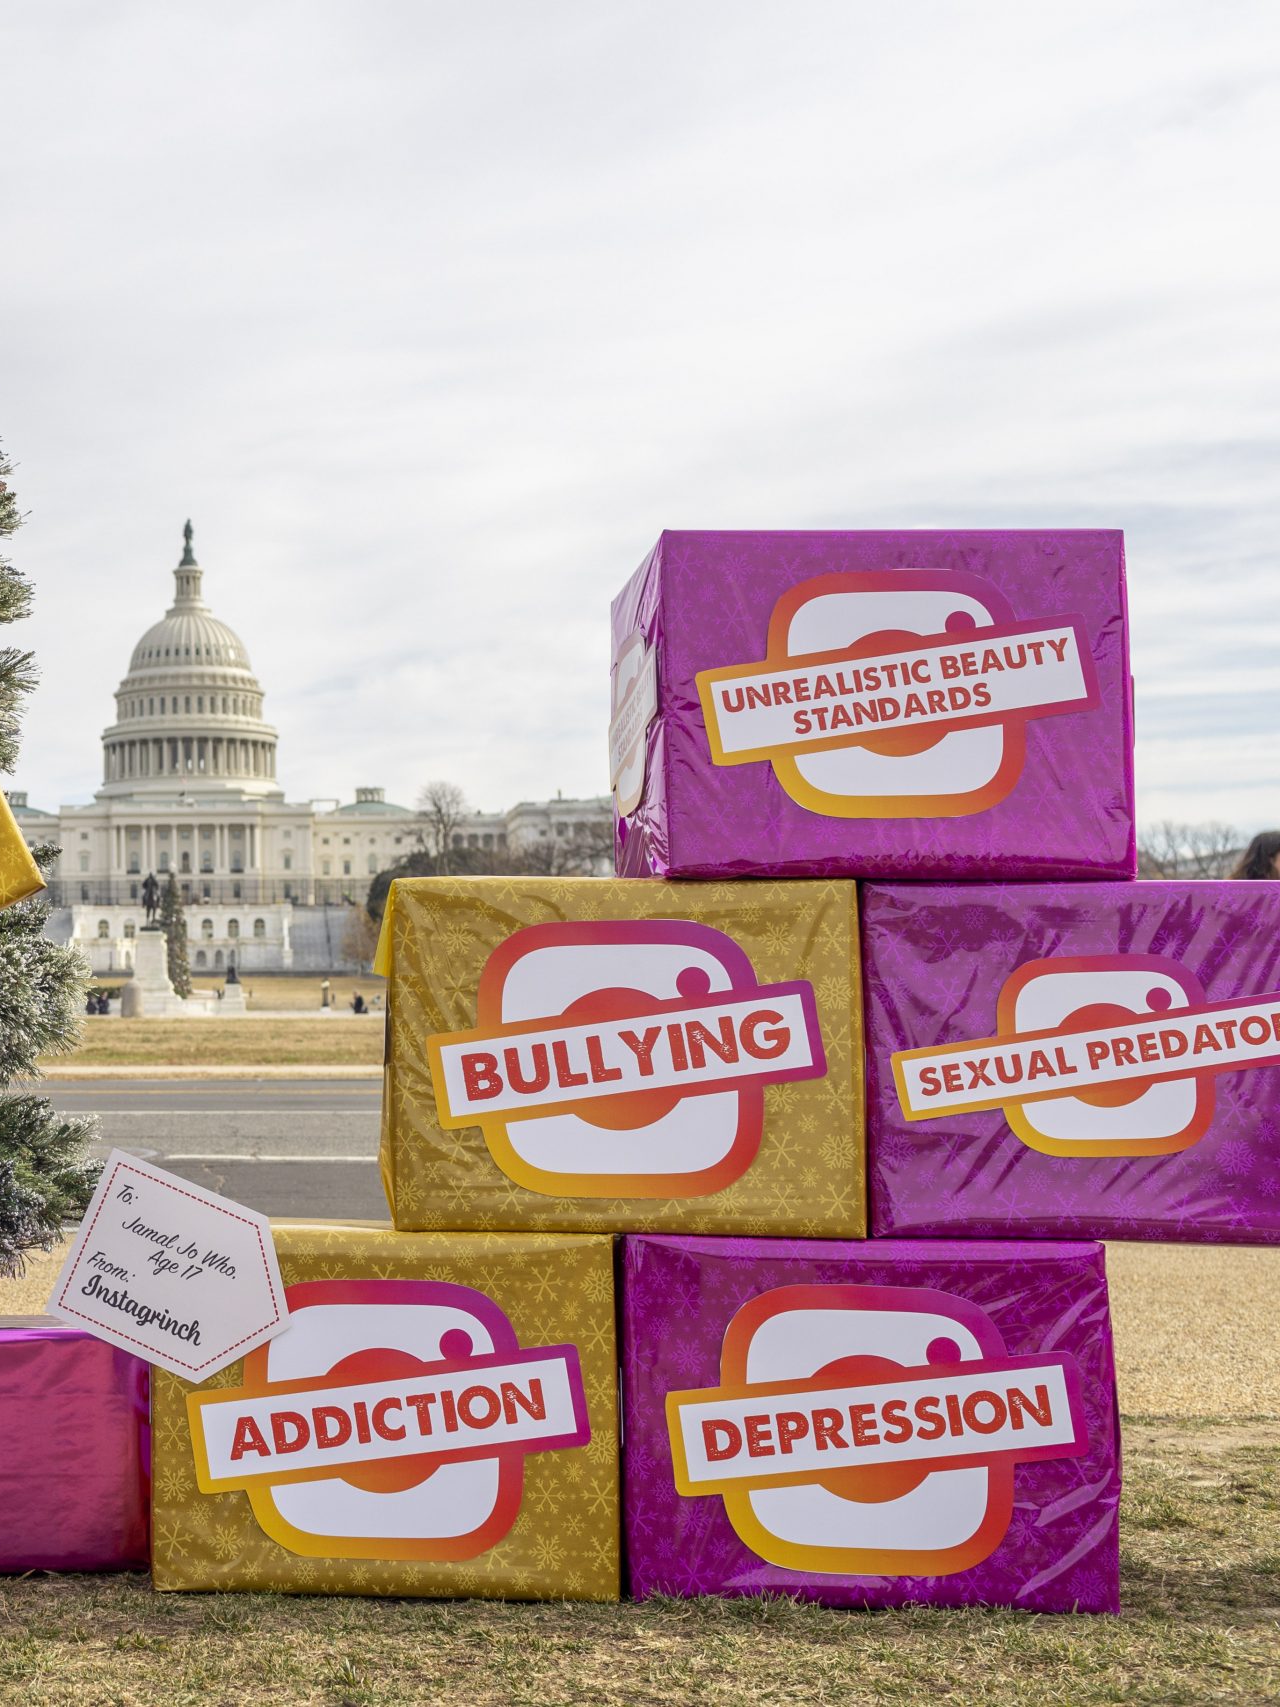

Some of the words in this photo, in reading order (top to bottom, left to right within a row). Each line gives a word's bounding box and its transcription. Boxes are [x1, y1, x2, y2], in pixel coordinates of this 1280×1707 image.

[723, 661, 930, 712] UNREALISTIC
[941, 639, 1066, 678] BEAUTY
[795, 684, 989, 734] STANDARDS
[462, 1010, 790, 1101] BULLYING
[920, 1049, 1076, 1095] SEXUAL
[116, 1184, 138, 1205] To:
[86, 1251, 136, 1282] From:
[122, 1216, 180, 1249] Jamal
[176, 1242, 198, 1260] Jo
[201, 1250, 236, 1280] Who,
[147, 1250, 178, 1276] Age
[180, 1264, 203, 1280] 17
[81, 1274, 201, 1346] Instagrinch
[231, 1379, 545, 1460] ADDICTION
[702, 1385, 1051, 1461] DEPRESSION
